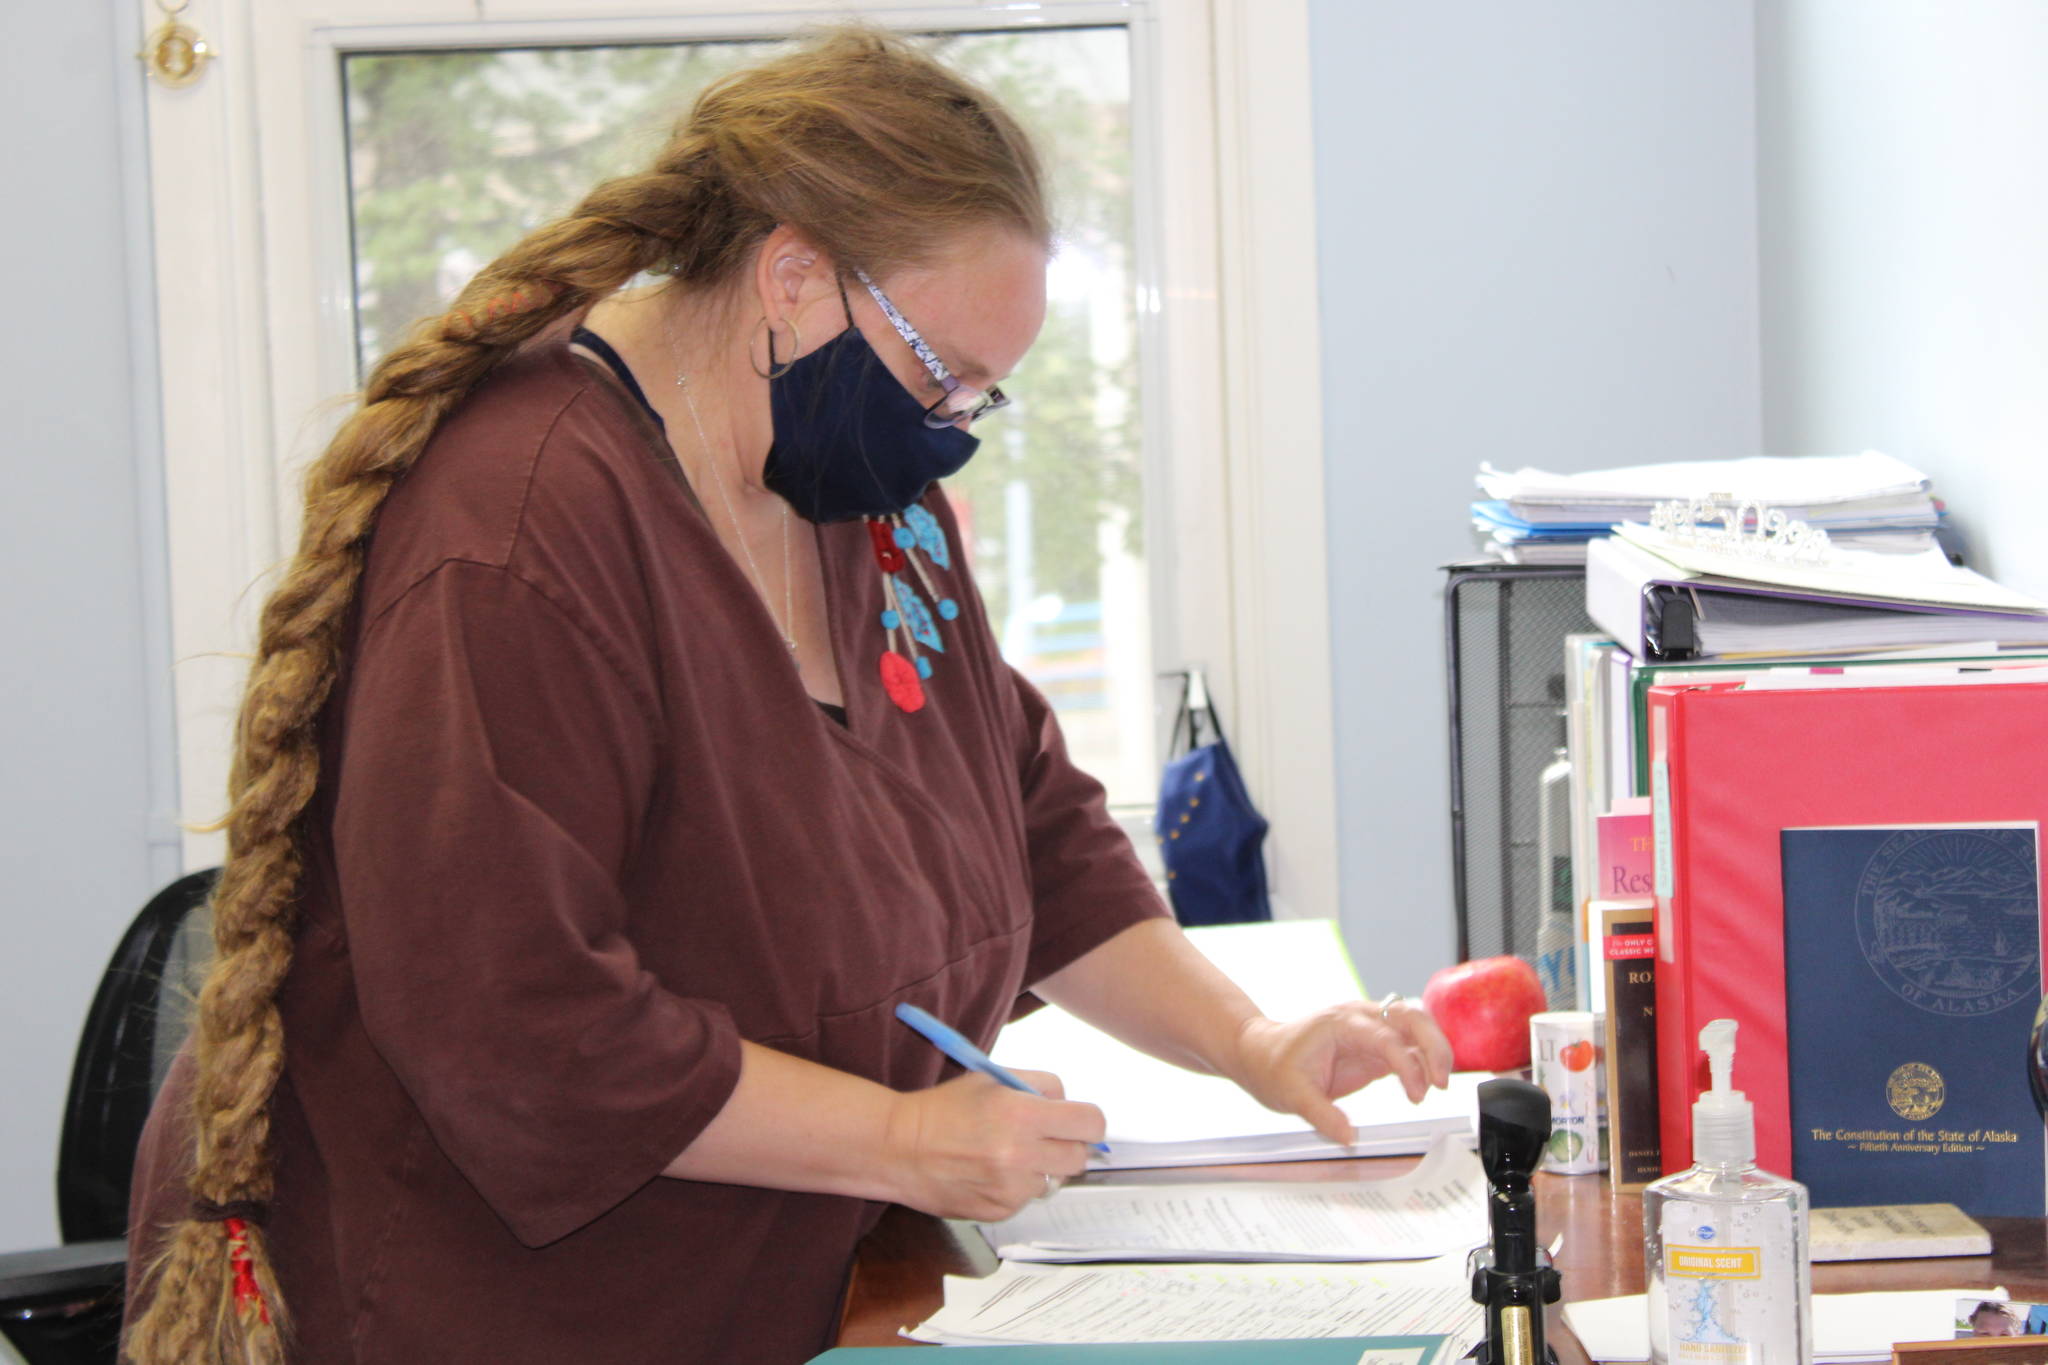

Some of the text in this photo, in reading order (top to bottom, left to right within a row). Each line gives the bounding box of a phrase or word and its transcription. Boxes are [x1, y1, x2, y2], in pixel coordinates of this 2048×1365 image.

[1612, 866, 1653, 893] Res
[1811, 1128, 2018, 1143] The Constitution of the State of Alaska
[1859, 1141, 1973, 1155] Fiftieth Anniversary Edition
[1679, 1255, 1743, 1269] ORIGINAL SCENT
